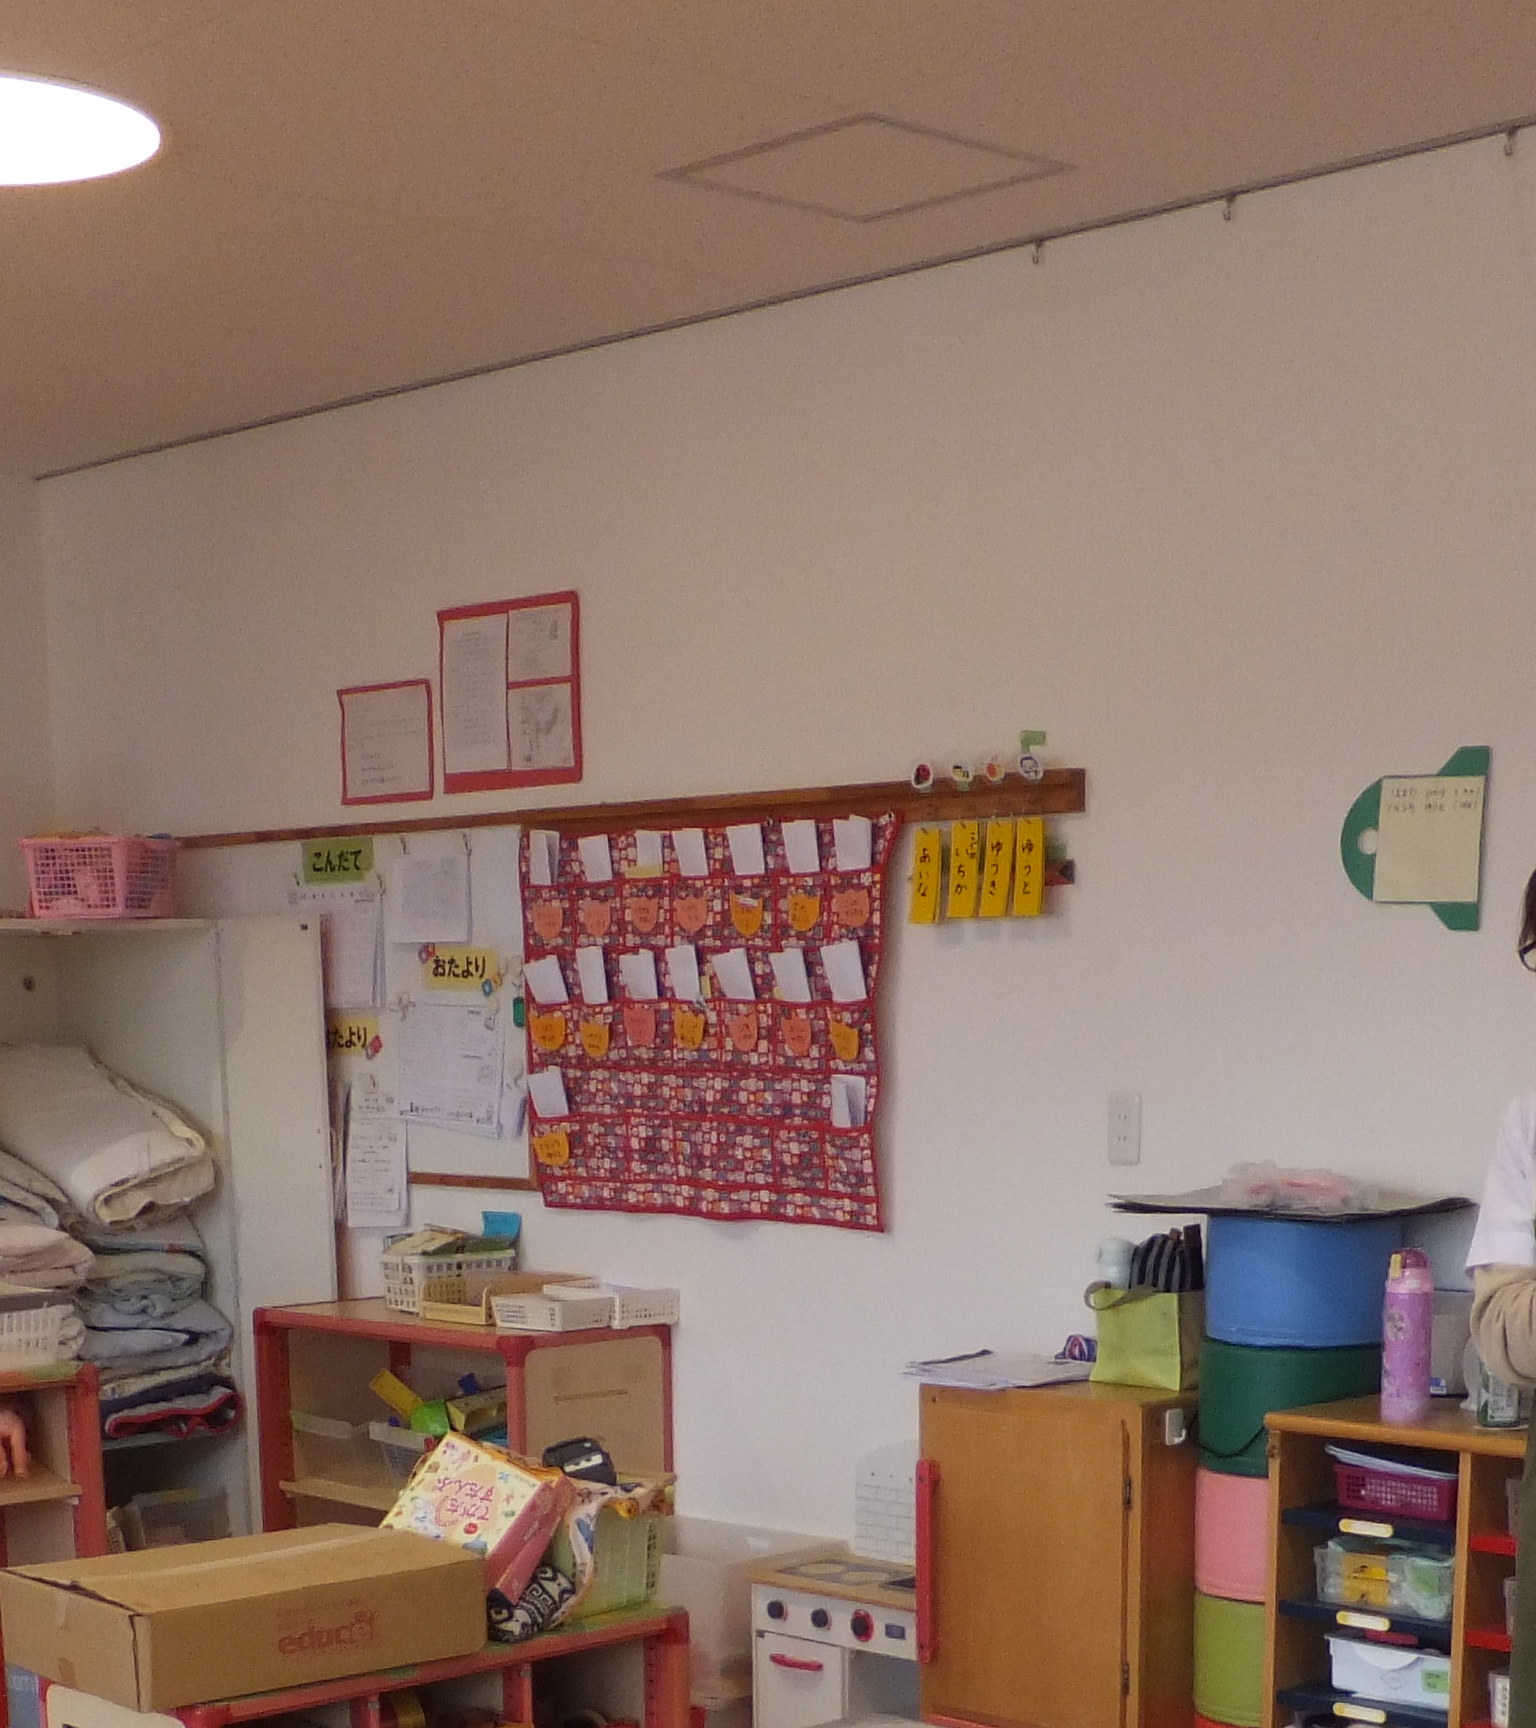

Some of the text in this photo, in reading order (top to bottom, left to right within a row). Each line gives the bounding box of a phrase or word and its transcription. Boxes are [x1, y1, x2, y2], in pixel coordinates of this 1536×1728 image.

[312, 848, 363, 873] こんだて
[432, 955, 487, 979] おたより
